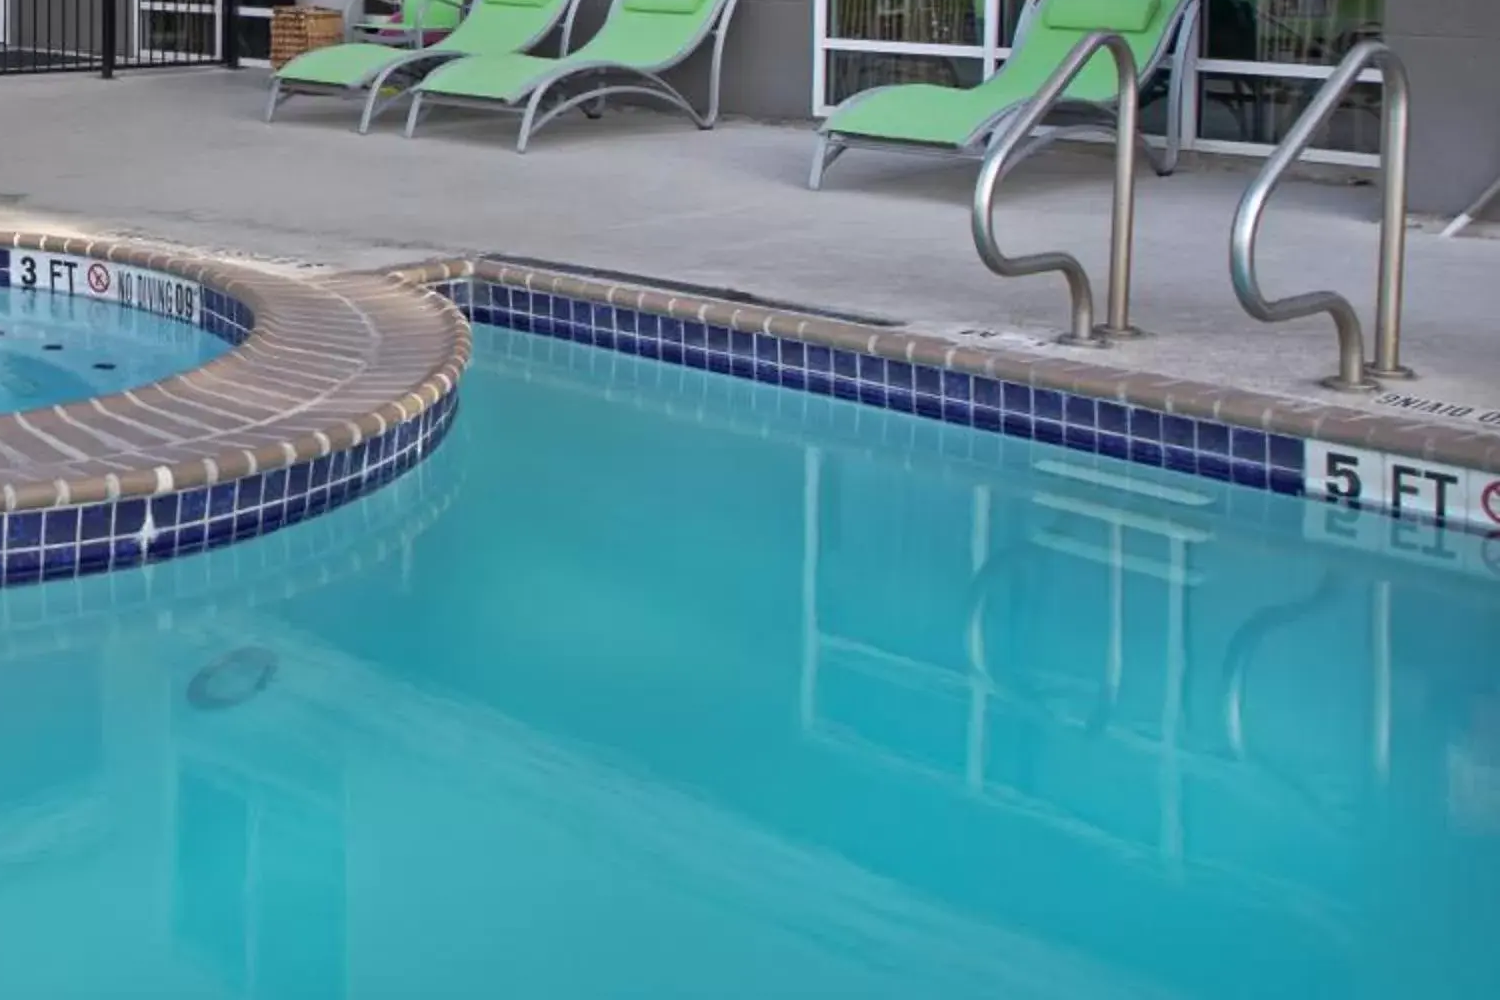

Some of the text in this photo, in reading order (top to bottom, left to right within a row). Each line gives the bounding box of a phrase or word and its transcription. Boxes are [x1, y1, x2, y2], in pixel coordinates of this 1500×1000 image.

[20, 256, 37, 290] 3
[50, 259, 78, 296] FT
[117, 270, 133, 307] NO
[137, 274, 173, 314] DIVING
[1375, 392, 1475, 417] DIVING
[1325, 451, 1458, 525] 5 FT
